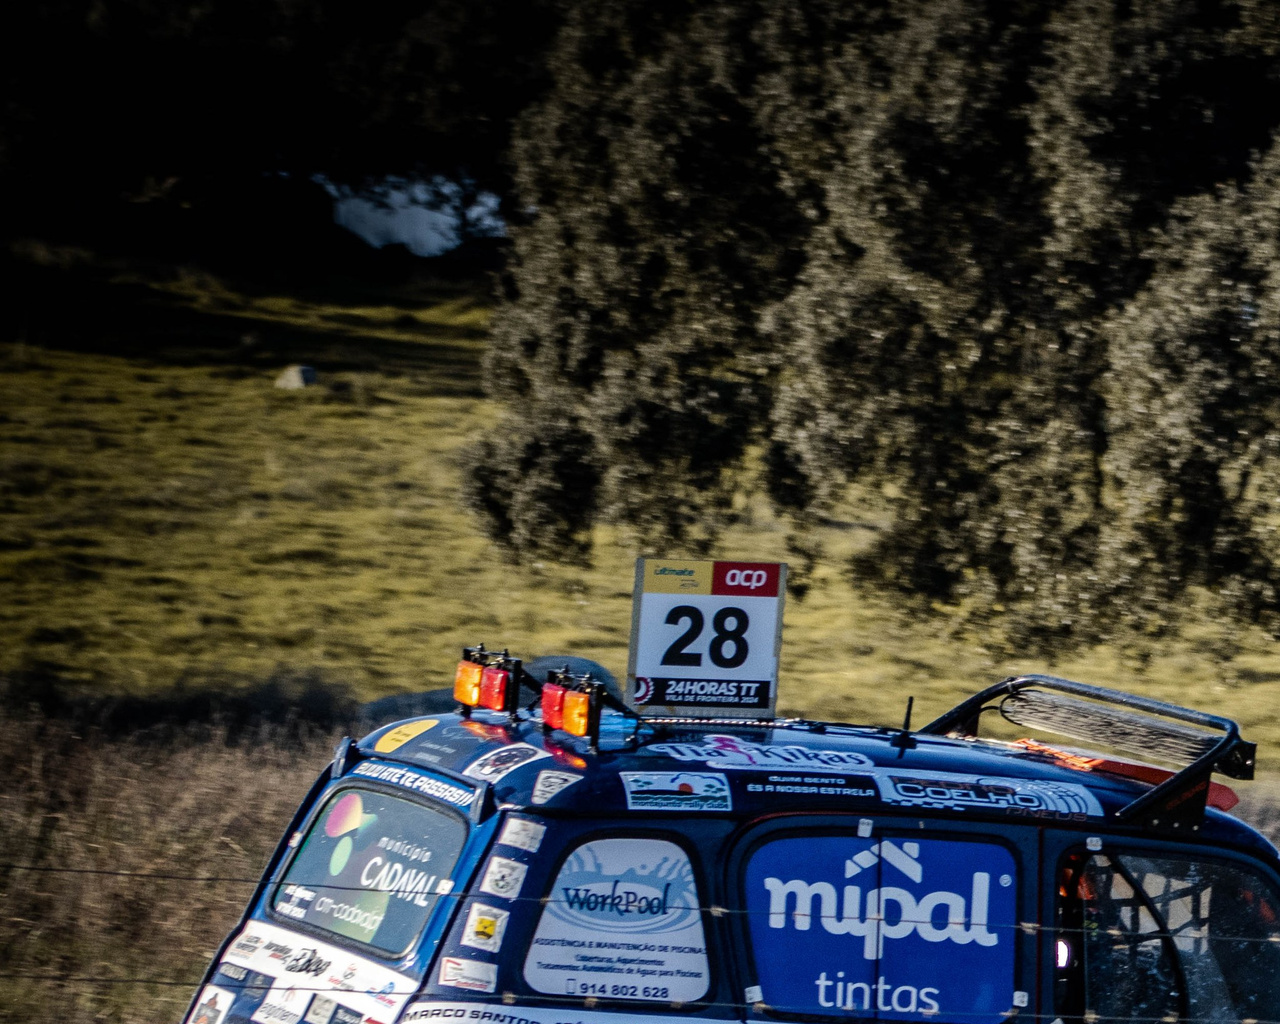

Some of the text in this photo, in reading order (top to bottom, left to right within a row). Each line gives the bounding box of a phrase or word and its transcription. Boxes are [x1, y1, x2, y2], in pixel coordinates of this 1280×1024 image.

[725, 569, 767, 590] acp
[660, 605, 749, 669] 28
[665, 681, 760, 696] 24HORAS TT
[660, 744, 866, 766] Tia Kikas
[771, 785, 818, 794] NOSSA
[825, 786, 876, 797] ESTRELA
[804, 777, 846, 785] BENTO
[897, 783, 1041, 807] COELHO
[1005, 806, 1088, 822] PNEUS
[360, 857, 437, 907] CADAVAL
[764, 872, 998, 960] mipal
[580, 983, 669, 999] 914 802 628
[815, 971, 940, 1013] tintas
[403, 1008, 466, 1022] MARCO
